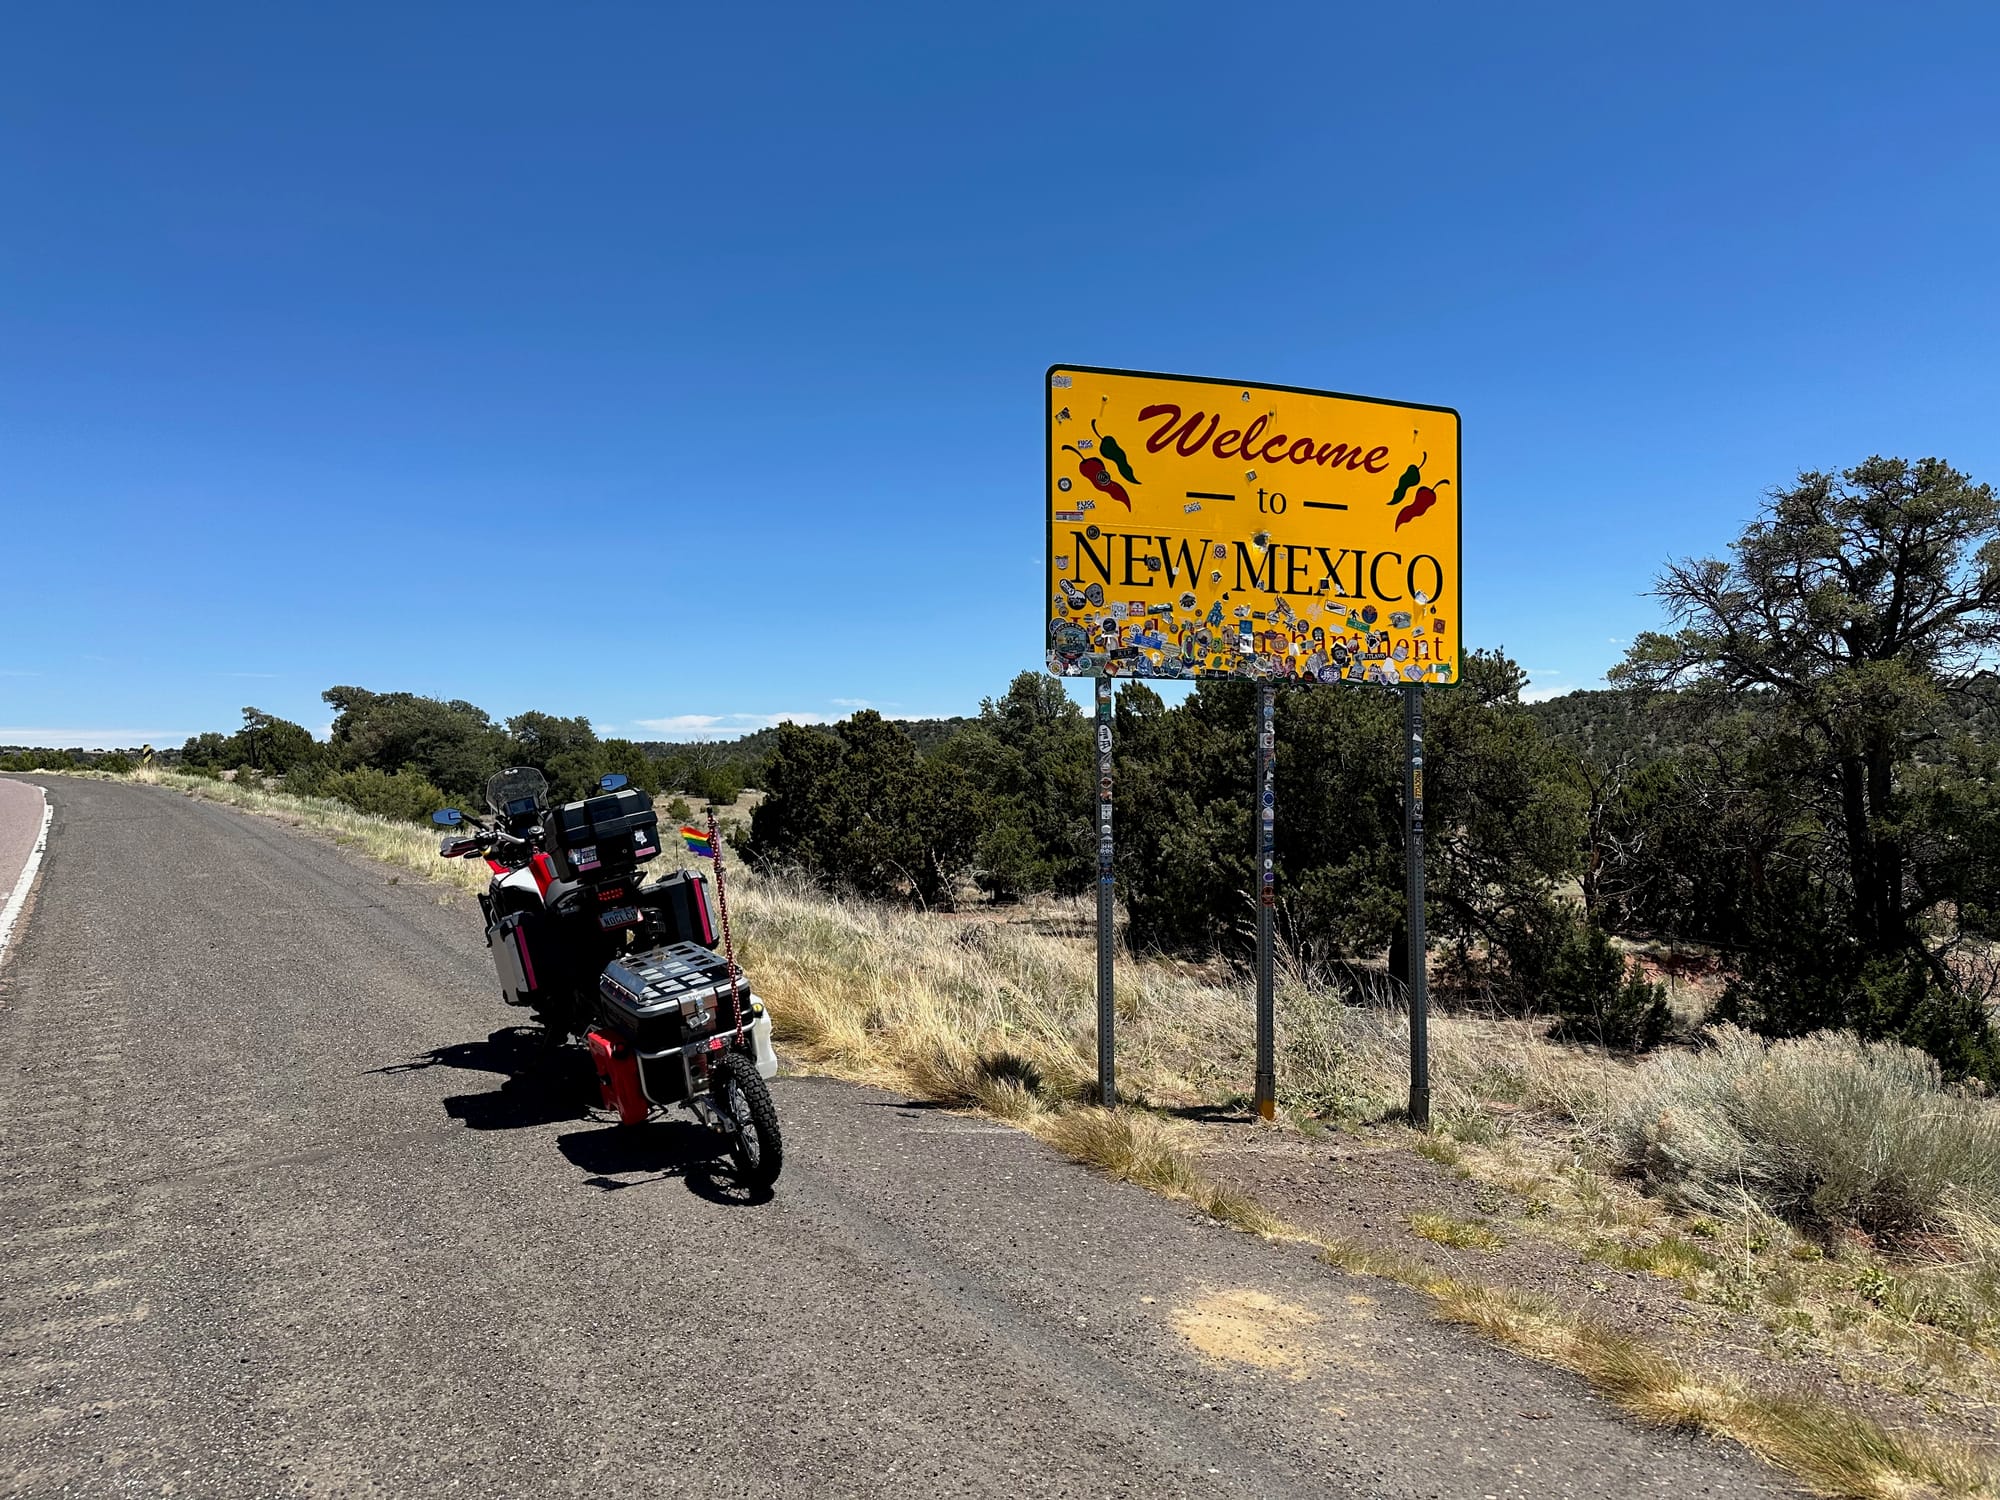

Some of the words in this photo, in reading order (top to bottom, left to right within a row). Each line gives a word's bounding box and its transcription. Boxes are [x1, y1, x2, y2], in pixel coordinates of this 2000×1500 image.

[1138, 404, 1389, 473] Welcome
[1257, 488, 1287, 514] to
[1070, 531, 1213, 590] NEW
[1232, 541, 1443, 604] MEXICO
